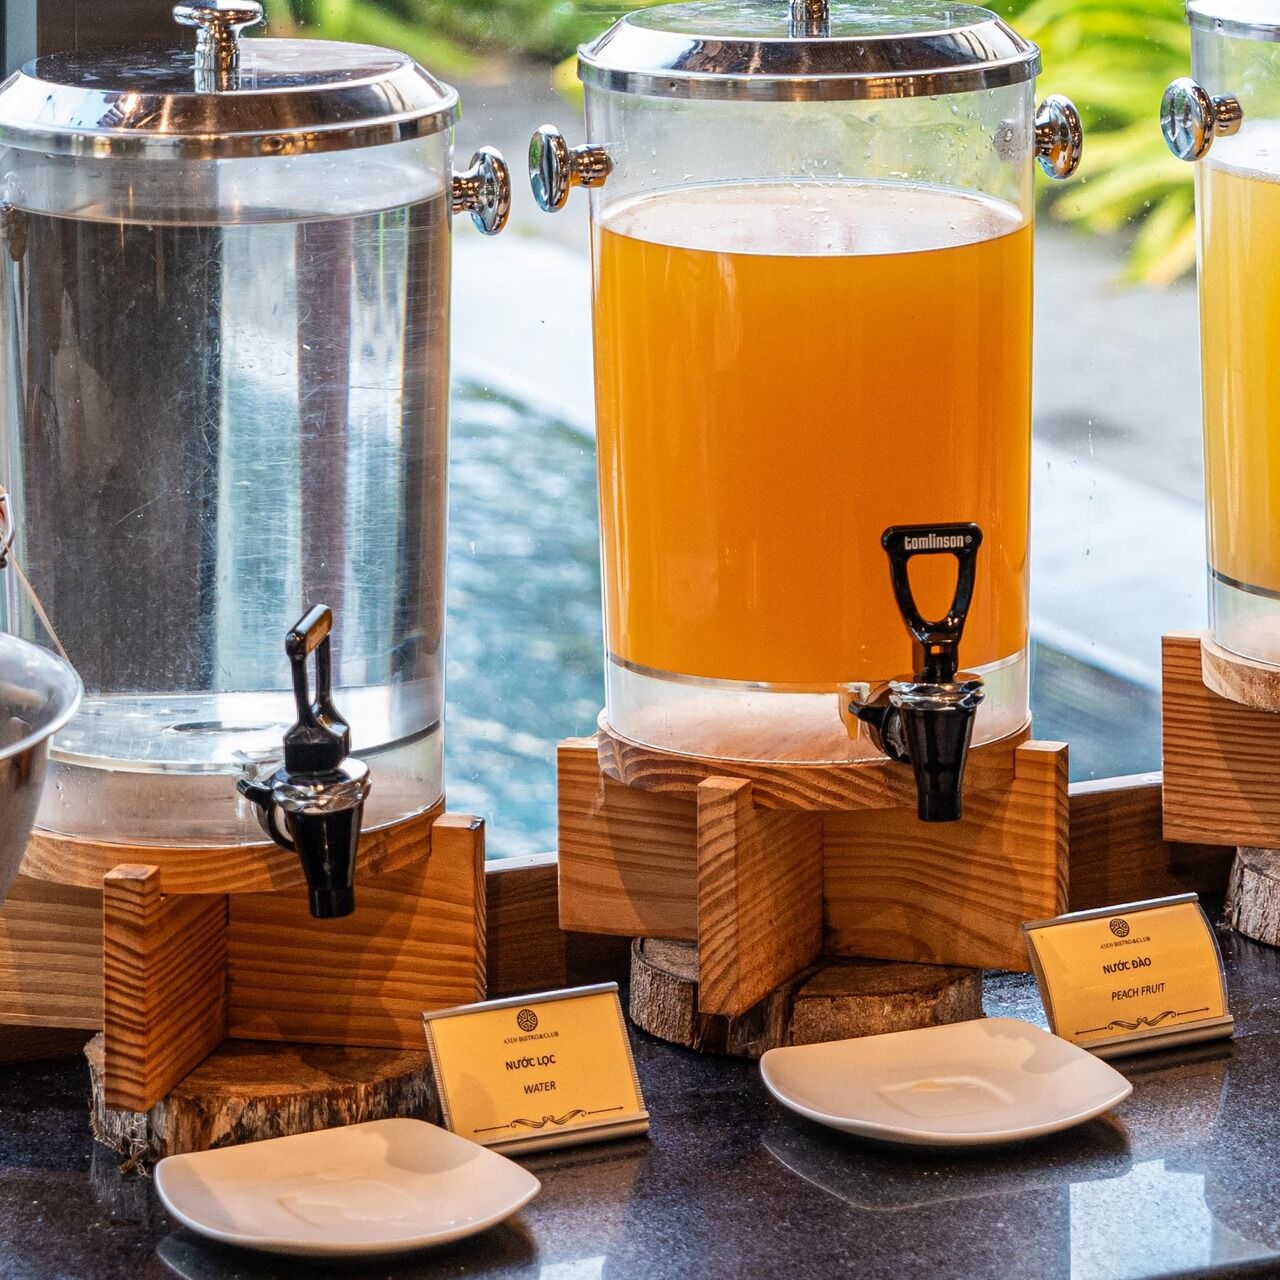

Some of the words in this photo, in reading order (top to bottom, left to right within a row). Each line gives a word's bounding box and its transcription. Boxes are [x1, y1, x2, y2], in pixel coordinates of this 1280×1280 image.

[1102, 960, 1131, 974] NƯỚC
[1131, 956, 1152, 969] ĐÀO
[1111, 987, 1139, 1001] PEACH
[1141, 982, 1166, 996] FRUIT
[505, 1056, 536, 1071] NƯỚC
[536, 1054, 557, 1067] LỌC
[523, 1080, 557, 1094] WATER
